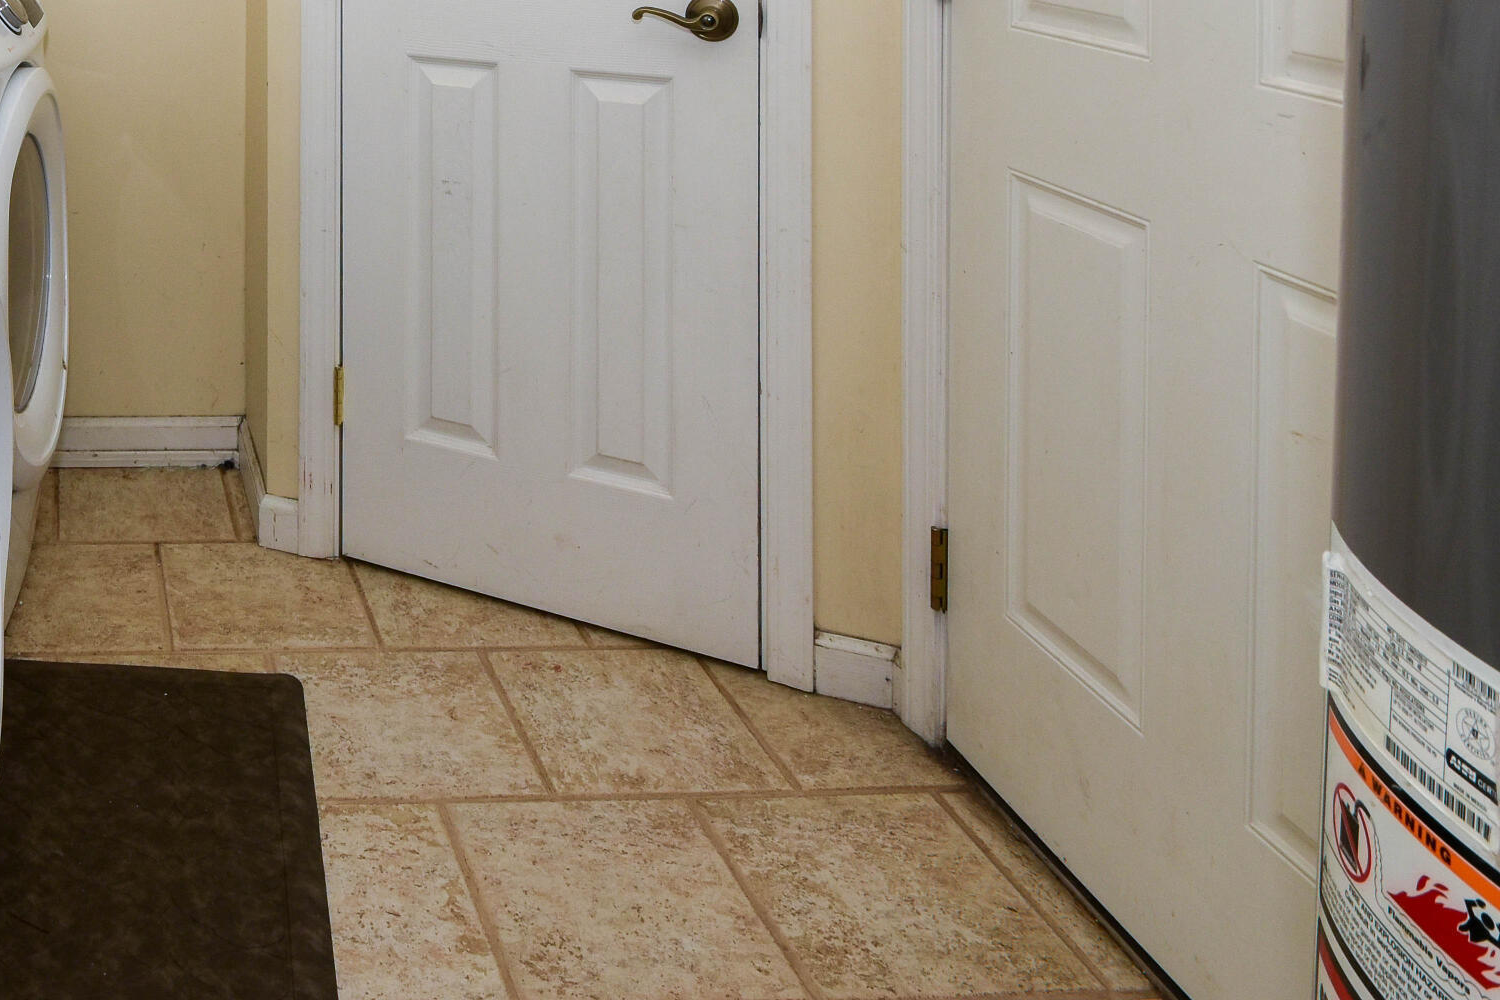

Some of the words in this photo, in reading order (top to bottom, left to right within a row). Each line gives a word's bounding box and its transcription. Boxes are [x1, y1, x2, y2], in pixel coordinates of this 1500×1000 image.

[1371, 775, 1452, 866] WARNING
[1361, 902, 1373, 923] AND
[1374, 919, 1414, 972] EXPLOSION
[1387, 904, 1434, 960] Flammable
[1435, 954, 1471, 996] Vapors
